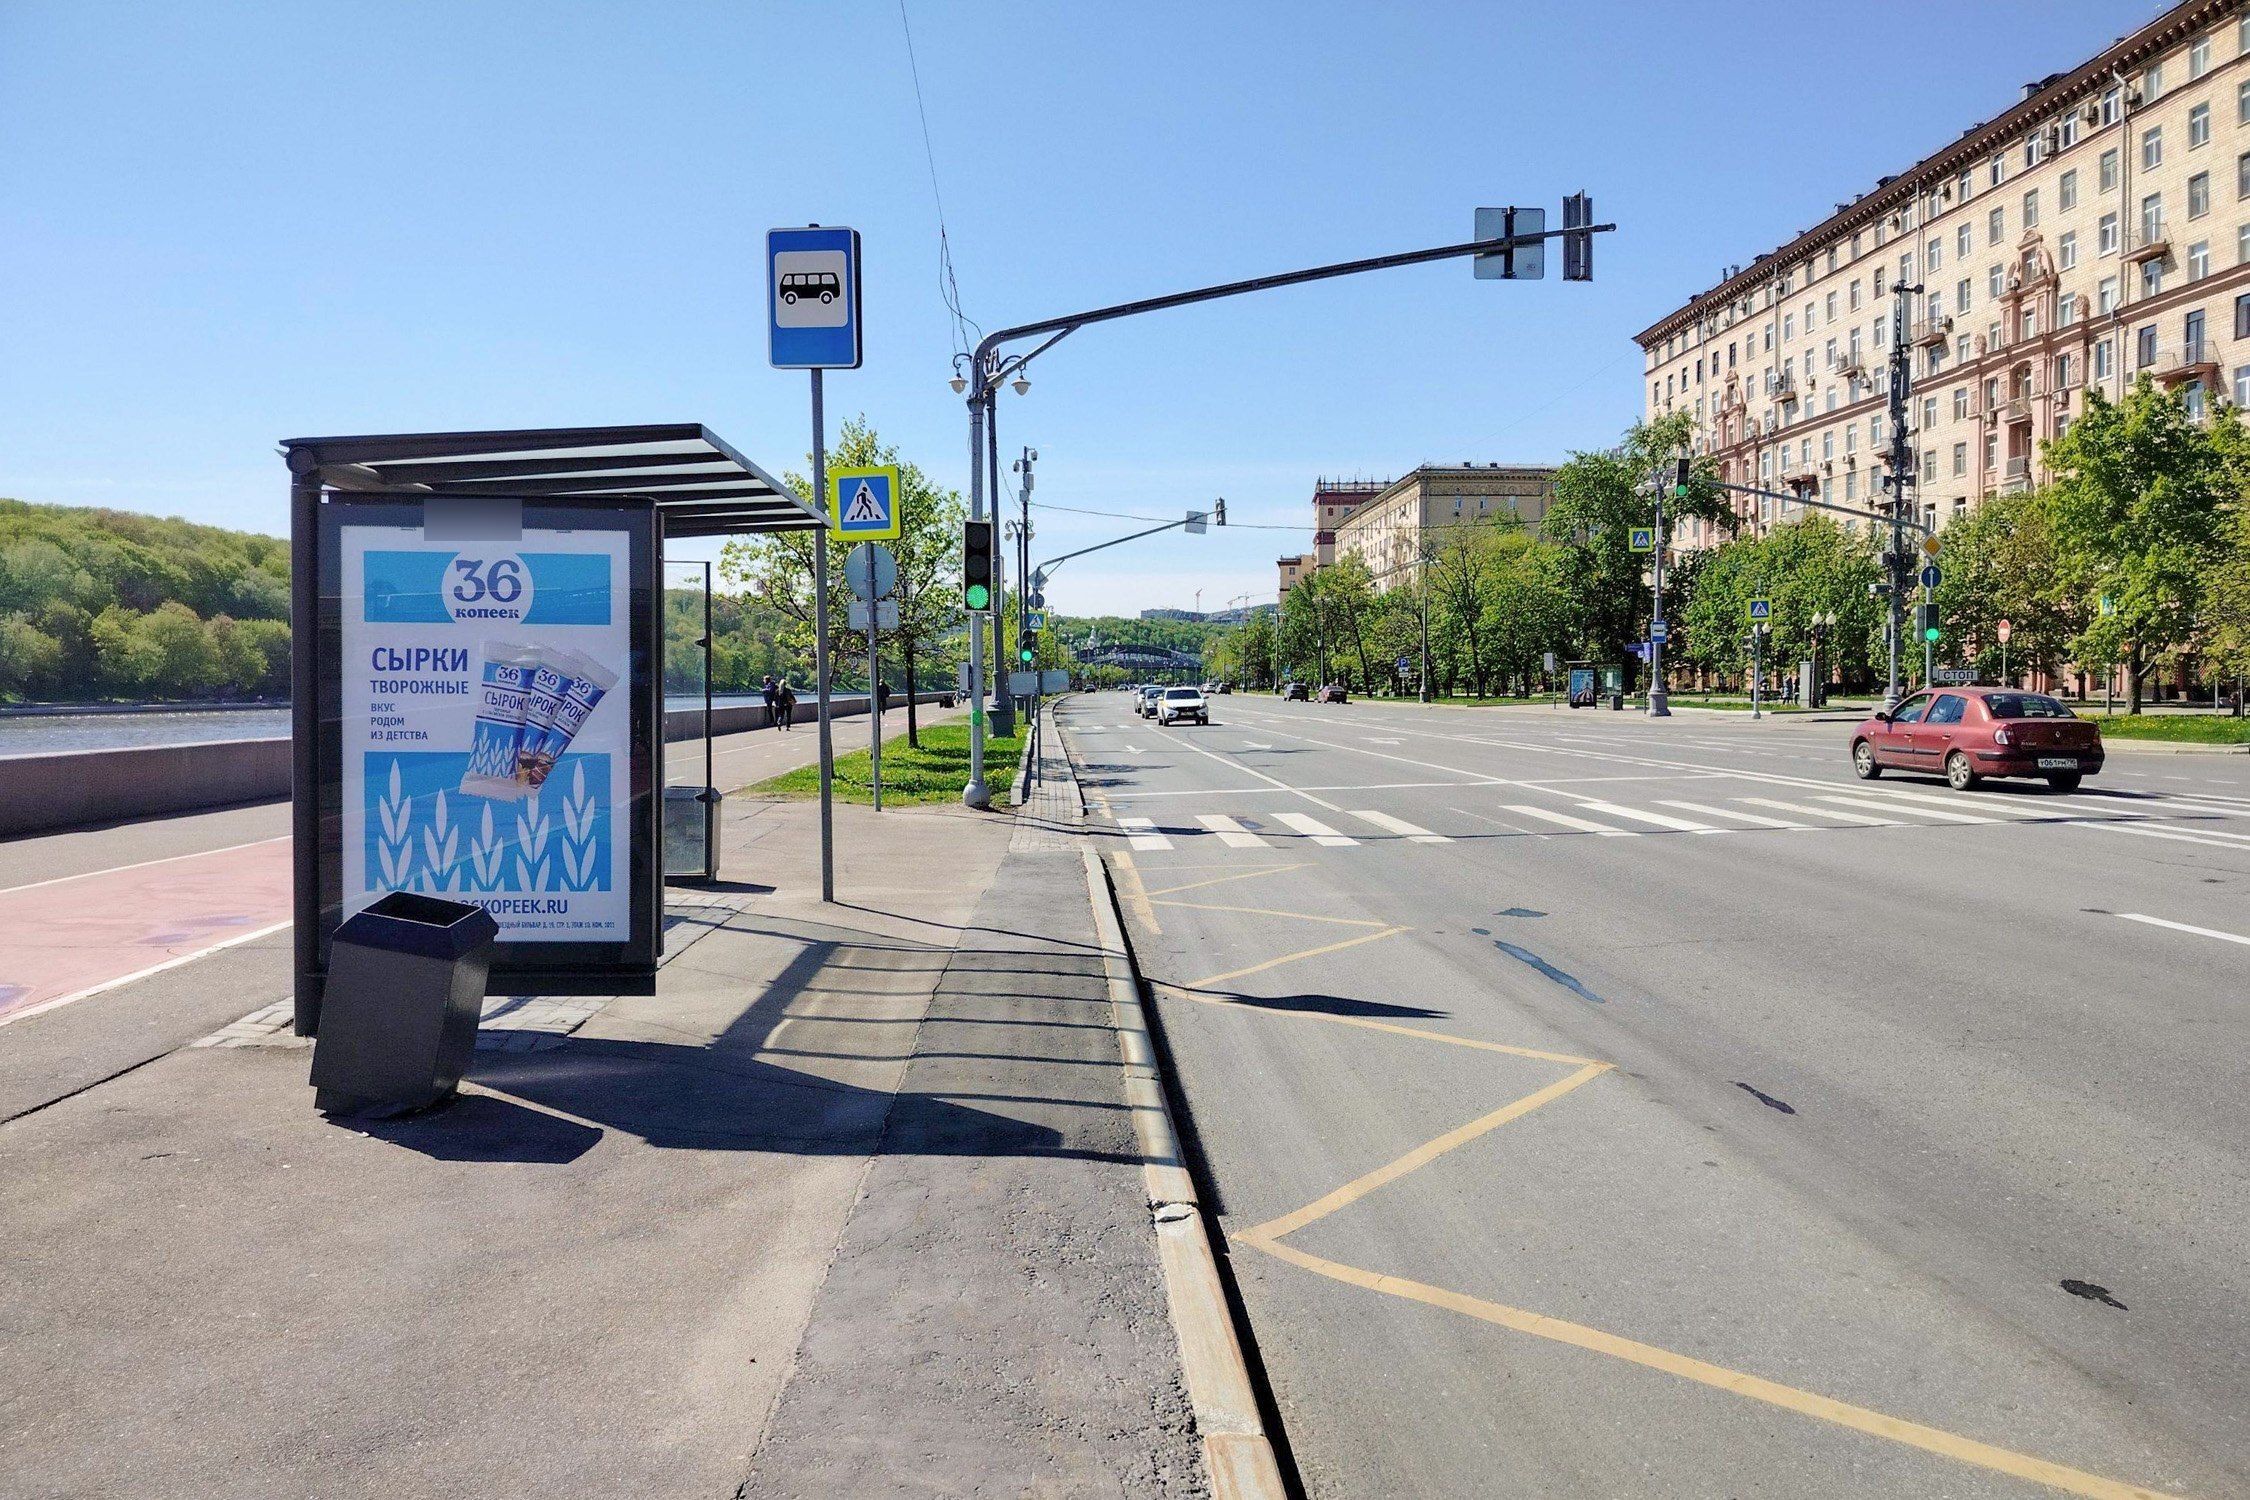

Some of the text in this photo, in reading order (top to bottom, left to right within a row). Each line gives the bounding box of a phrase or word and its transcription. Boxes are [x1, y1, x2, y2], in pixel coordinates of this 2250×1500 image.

[453, 559, 522, 602] 36
[455, 608, 520, 619] копеек
[372, 647, 468, 672] СЫРКИ
[498, 666, 519, 681] 36
[538, 669, 559, 686] 36
[1943, 671, 1974, 680] СТОП
[370, 680, 469, 694] ТВОРОЖНЫЕ
[572, 676, 592, 694] 36
[370, 703, 396, 712] ВКУС
[484, 690, 526, 711] СЫРОК
[370, 717, 405, 727] РОДОМ
[370, 731, 428, 741] ИЗ ДЕТСТВА
